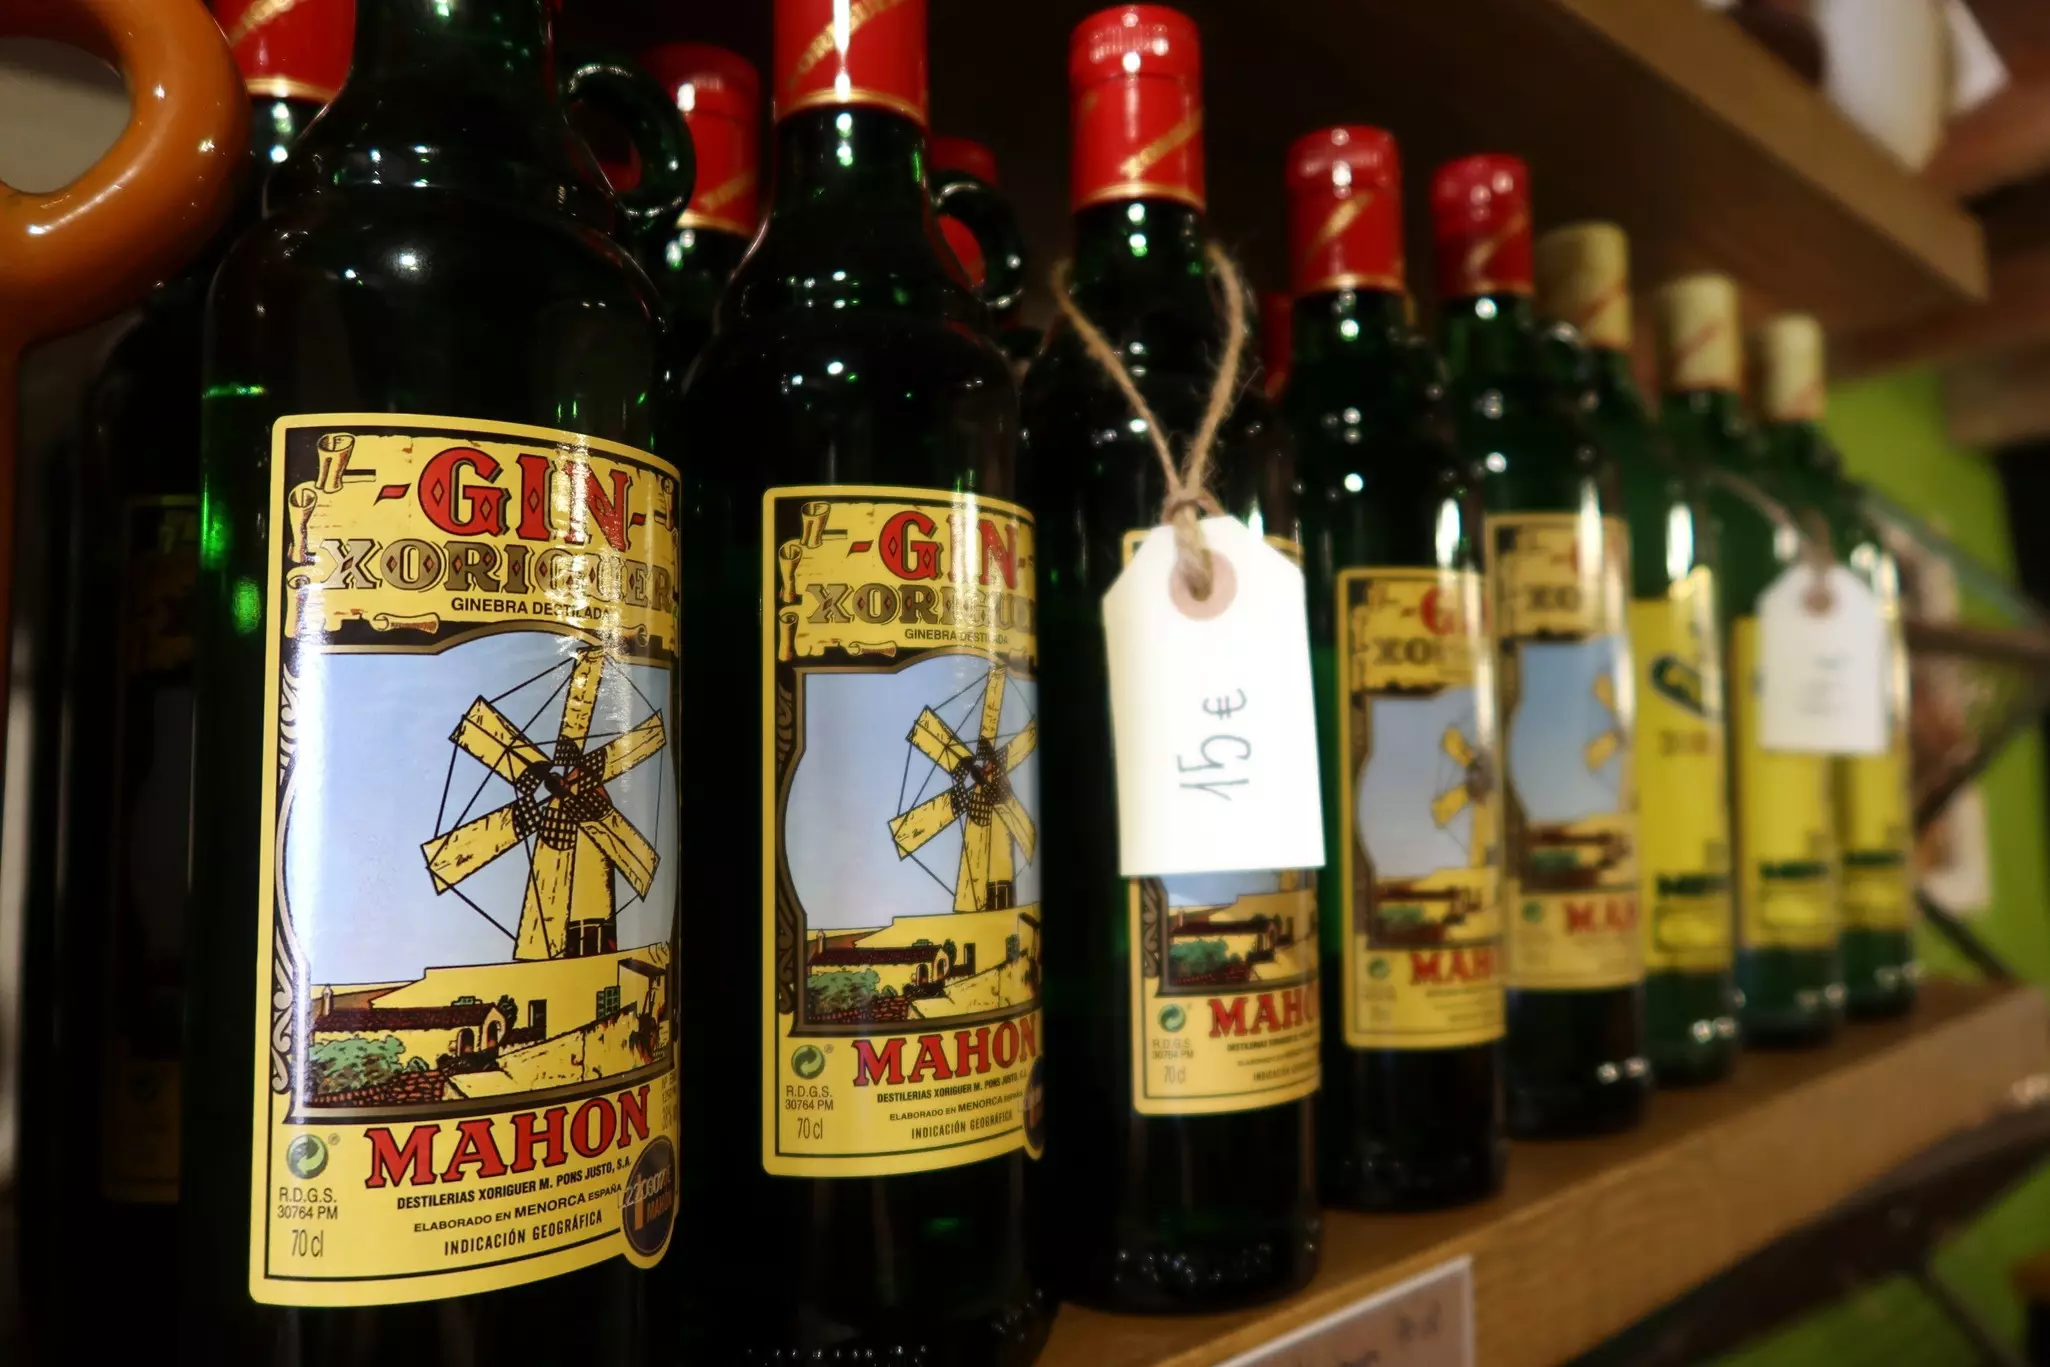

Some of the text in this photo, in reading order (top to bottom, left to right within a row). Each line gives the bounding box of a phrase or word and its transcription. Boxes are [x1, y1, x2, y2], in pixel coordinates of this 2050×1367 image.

[451, 597, 528, 614] GINEBRA
[904, 628, 957, 642] GINEBRA
[785, 1085, 832, 1098] R.D.G.S.
[877, 1090, 932, 1103] DESTILERIAS
[934, 1083, 972, 1097] XORIGUER
[784, 1099, 834, 1111] 30764 PM
[889, 1108, 944, 1121] ELABORADO
[945, 1106, 956, 1115] EN
[957, 1095, 1003, 1112] MENORCA
[362, 1084, 651, 1189] MAHON
[797, 1117, 823, 1140] 70 cl
[911, 1122, 966, 1139] INDICACIÓN
[279, 1186, 338, 1203] R.D.G.S.
[397, 1190, 475, 1210] DESTILERIAS
[478, 1180, 537, 1201] XORIGUER
[539, 1177, 553, 1191] M.
[556, 1172, 583, 1187] PONS
[277, 1204, 338, 1220] 30764 PM
[413, 1183, 622, 1233] ELABORADO EN MENORCA ESPAÑA
[444, 1208, 603, 1256] INDICACIÓN GEOGRÁFICA
[291, 1229, 324, 1258] 70 cl
